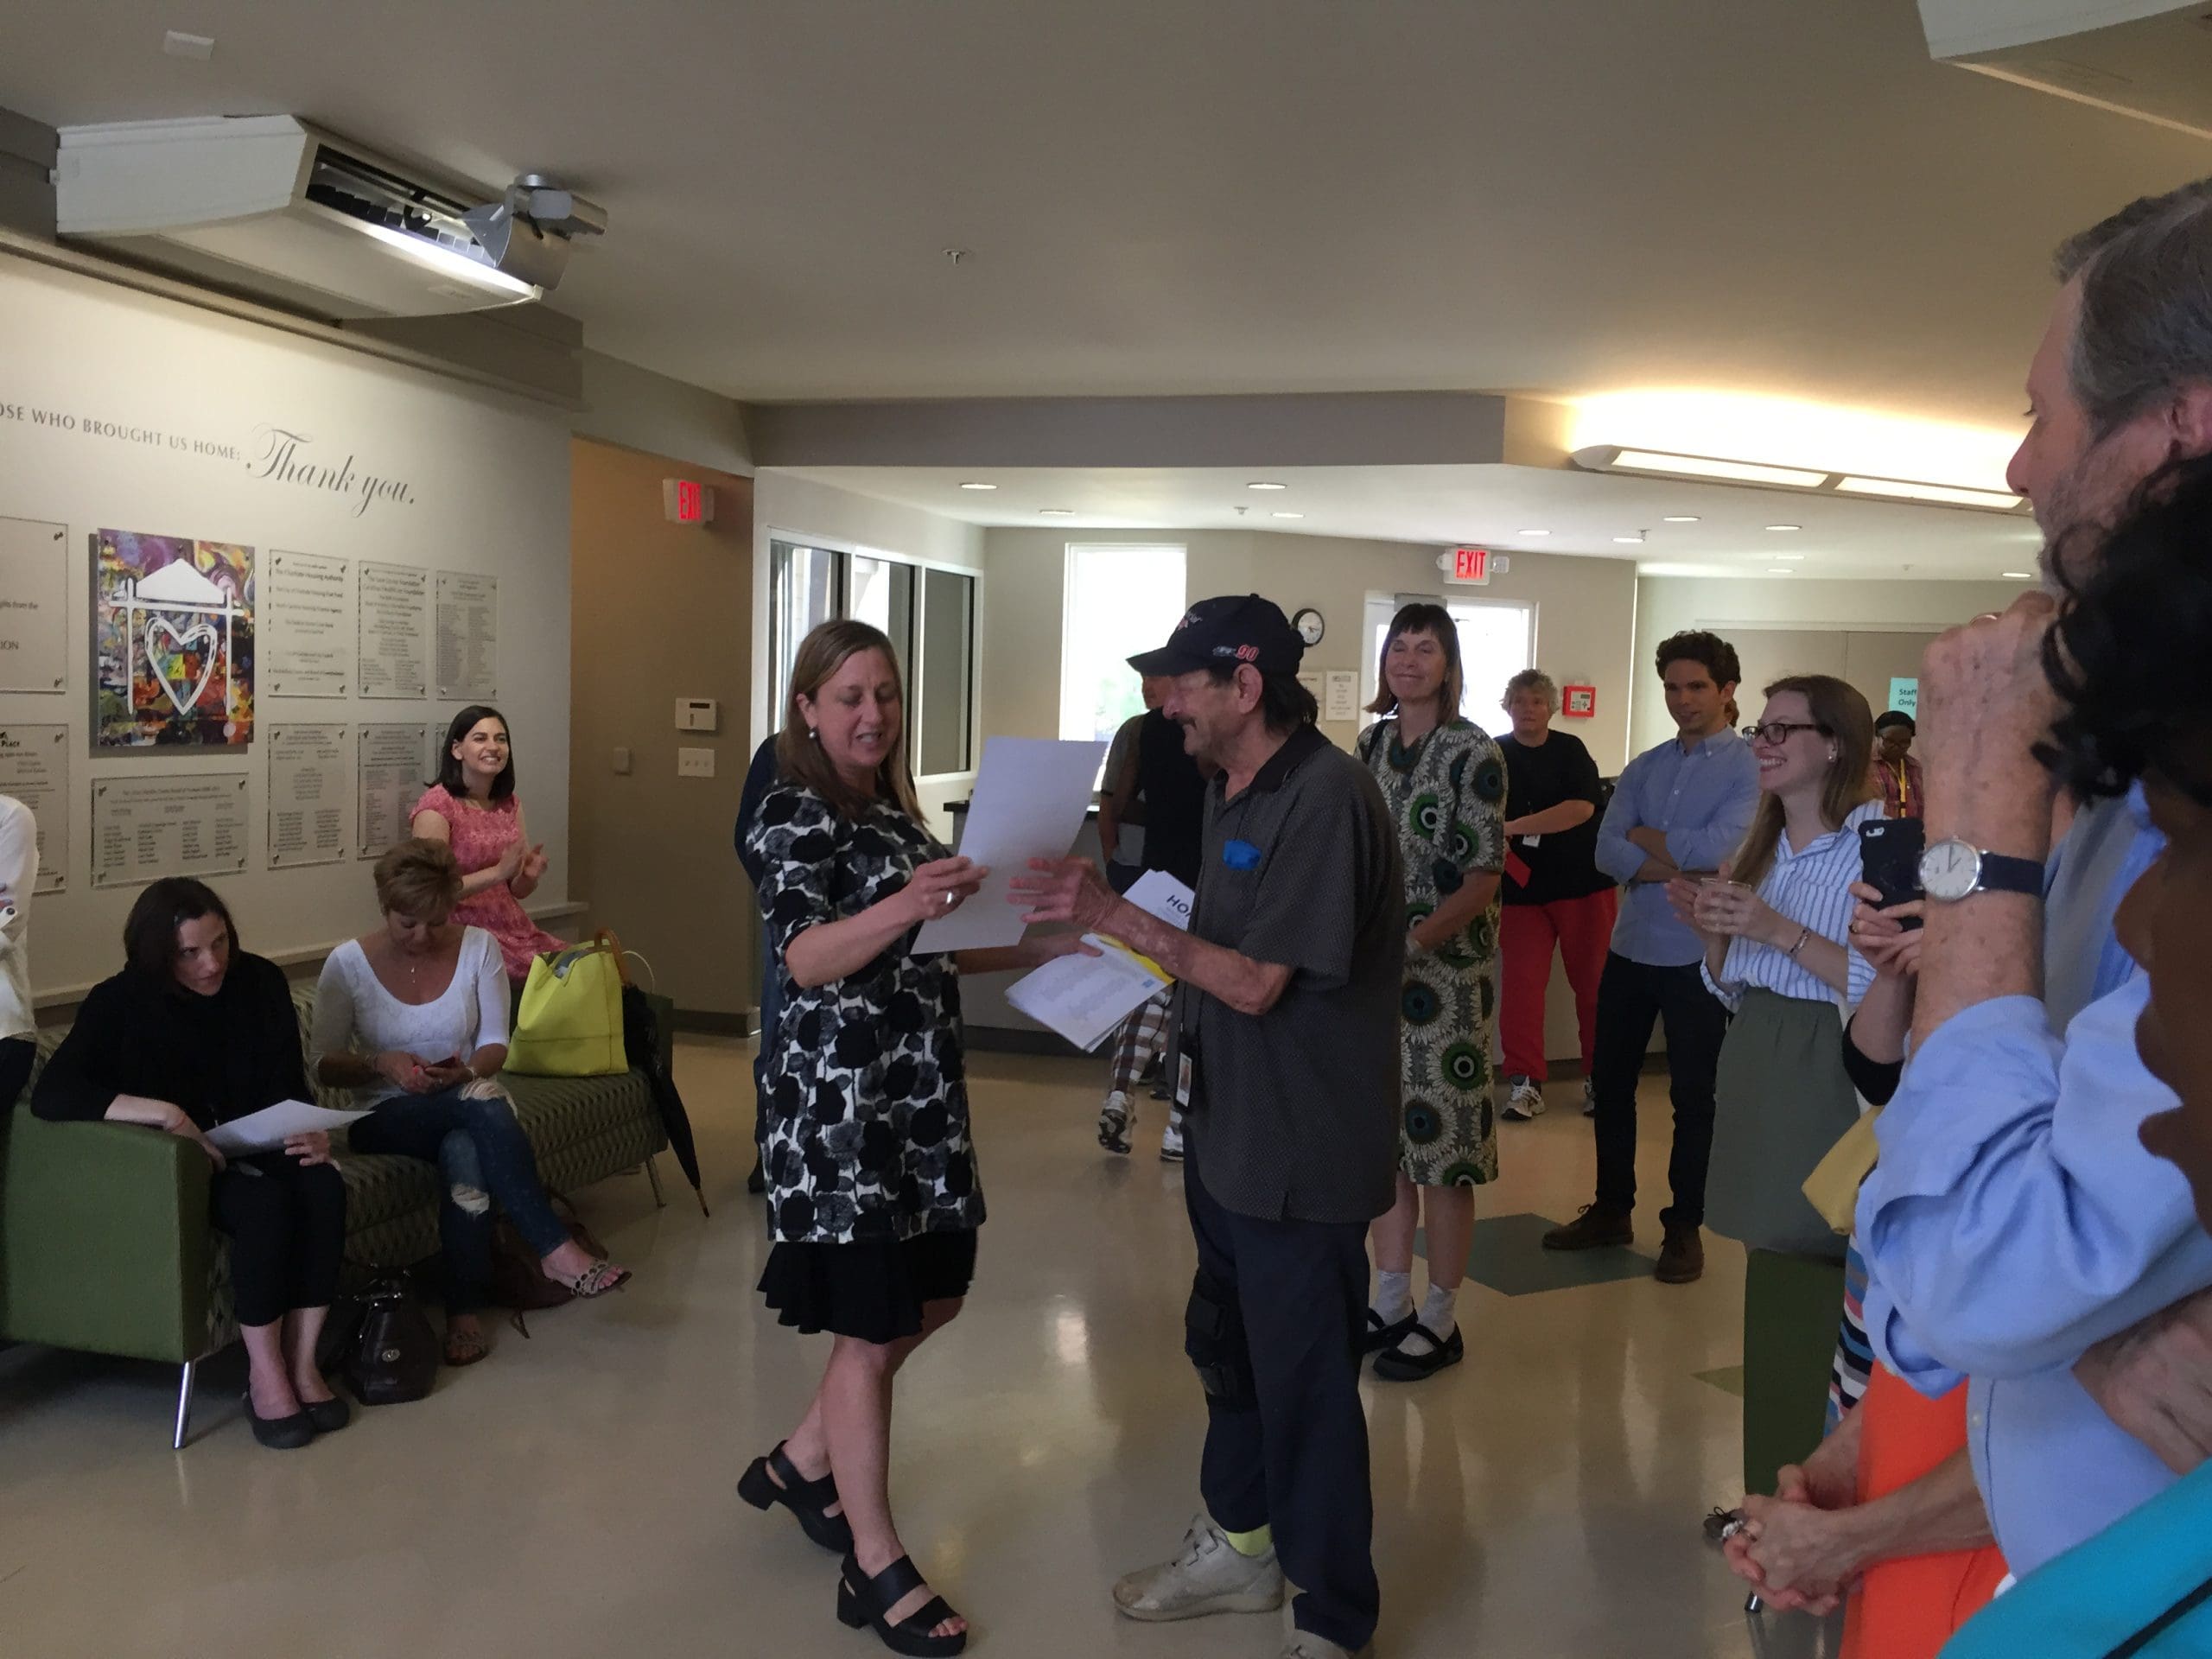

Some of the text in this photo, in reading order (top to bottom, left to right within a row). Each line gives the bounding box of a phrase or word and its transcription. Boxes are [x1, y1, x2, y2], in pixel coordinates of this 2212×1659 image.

[32, 409, 76, 430] WHO
[83, 418, 162, 446] BROUGHT
[169, 435, 188, 452] US
[246, 422, 355, 493] Thank
[352, 475, 415, 518] you.
[1456, 549, 1486, 579] EXIT
